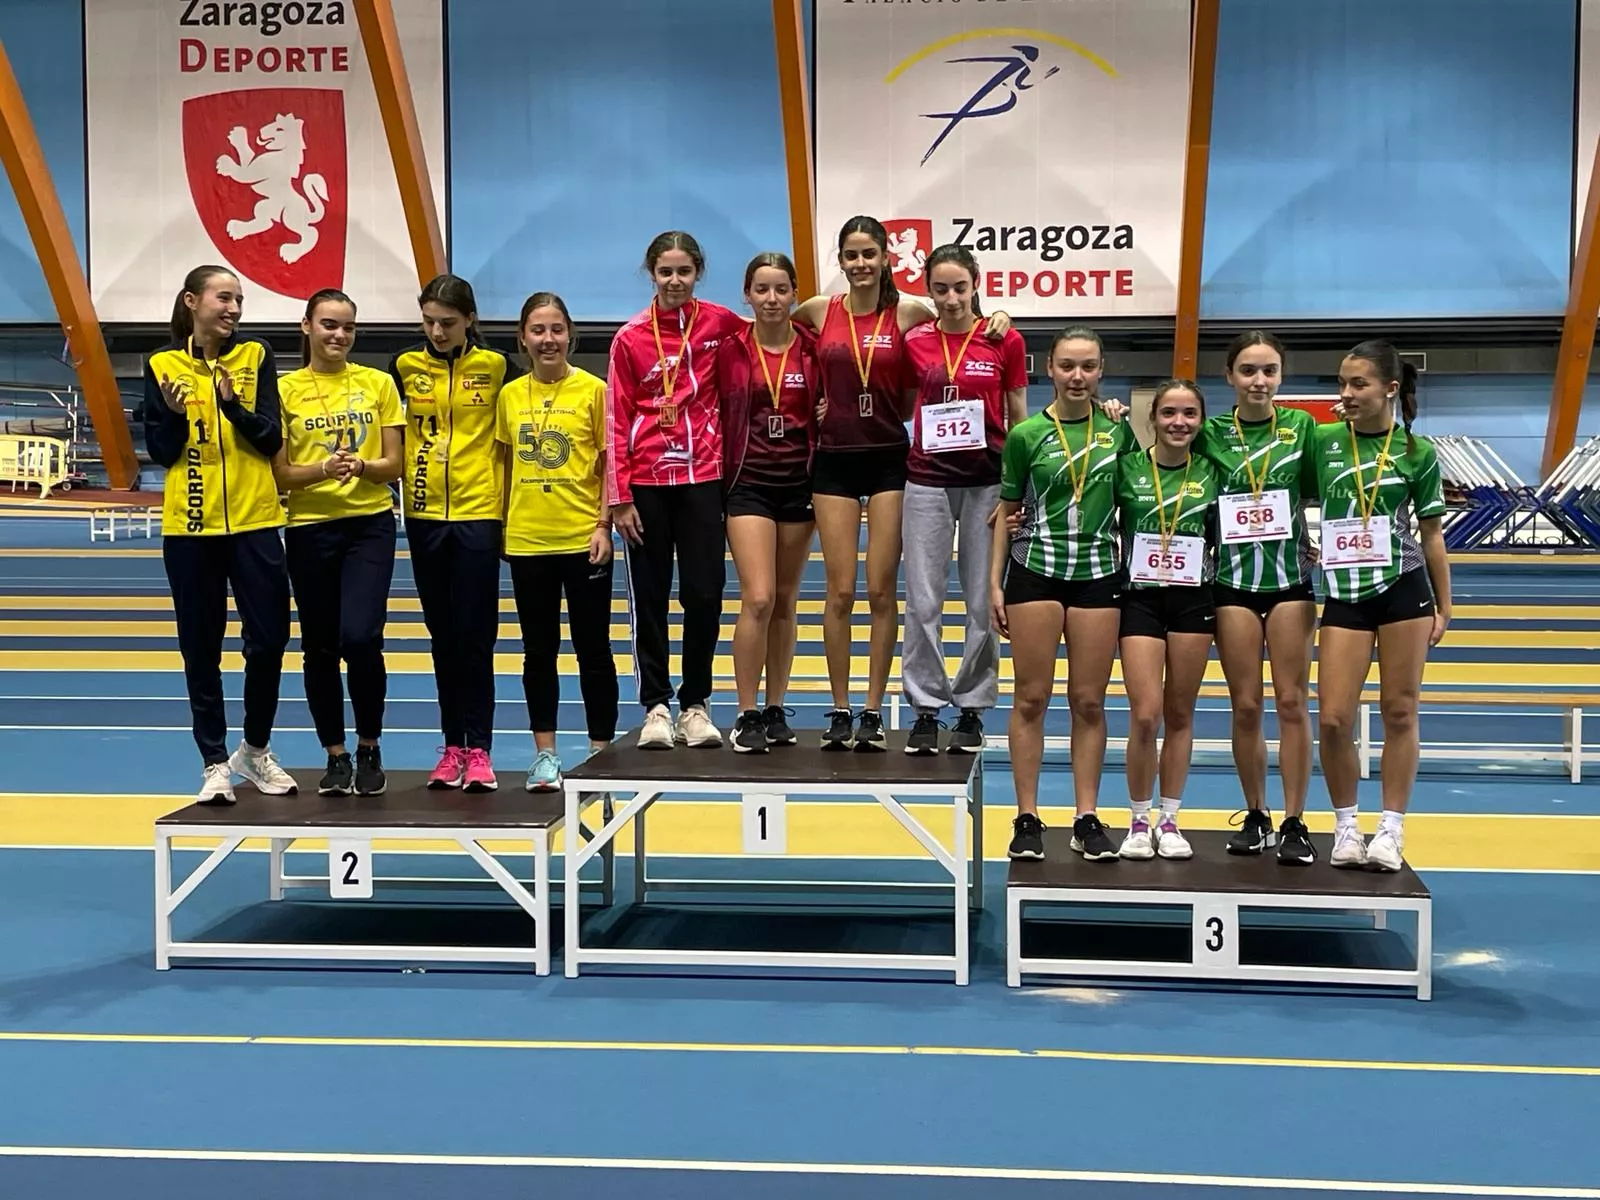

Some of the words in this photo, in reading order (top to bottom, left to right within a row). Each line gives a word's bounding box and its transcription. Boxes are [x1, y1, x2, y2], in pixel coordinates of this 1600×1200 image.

[180, 0, 345, 36] Zaragoza
[180, 38, 349, 73] DEPORTE
[952, 218, 1134, 262] Zaragoza
[976, 270, 1133, 297] EPORTE
[785, 373, 804, 383] ZG
[304, 412, 373, 432] SCORPIO
[413, 414, 439, 437] 71
[936, 421, 971, 438] 512
[518, 423, 570, 470] 50
[187, 447, 204, 533] SCORPIO
[413, 440, 434, 512] SCORPIO
[1236, 508, 1274, 526] 638
[1148, 553, 1186, 570] 655
[758, 806, 767, 841] 1
[341, 851, 359, 885] 2
[1205, 916, 1224, 952] 3
